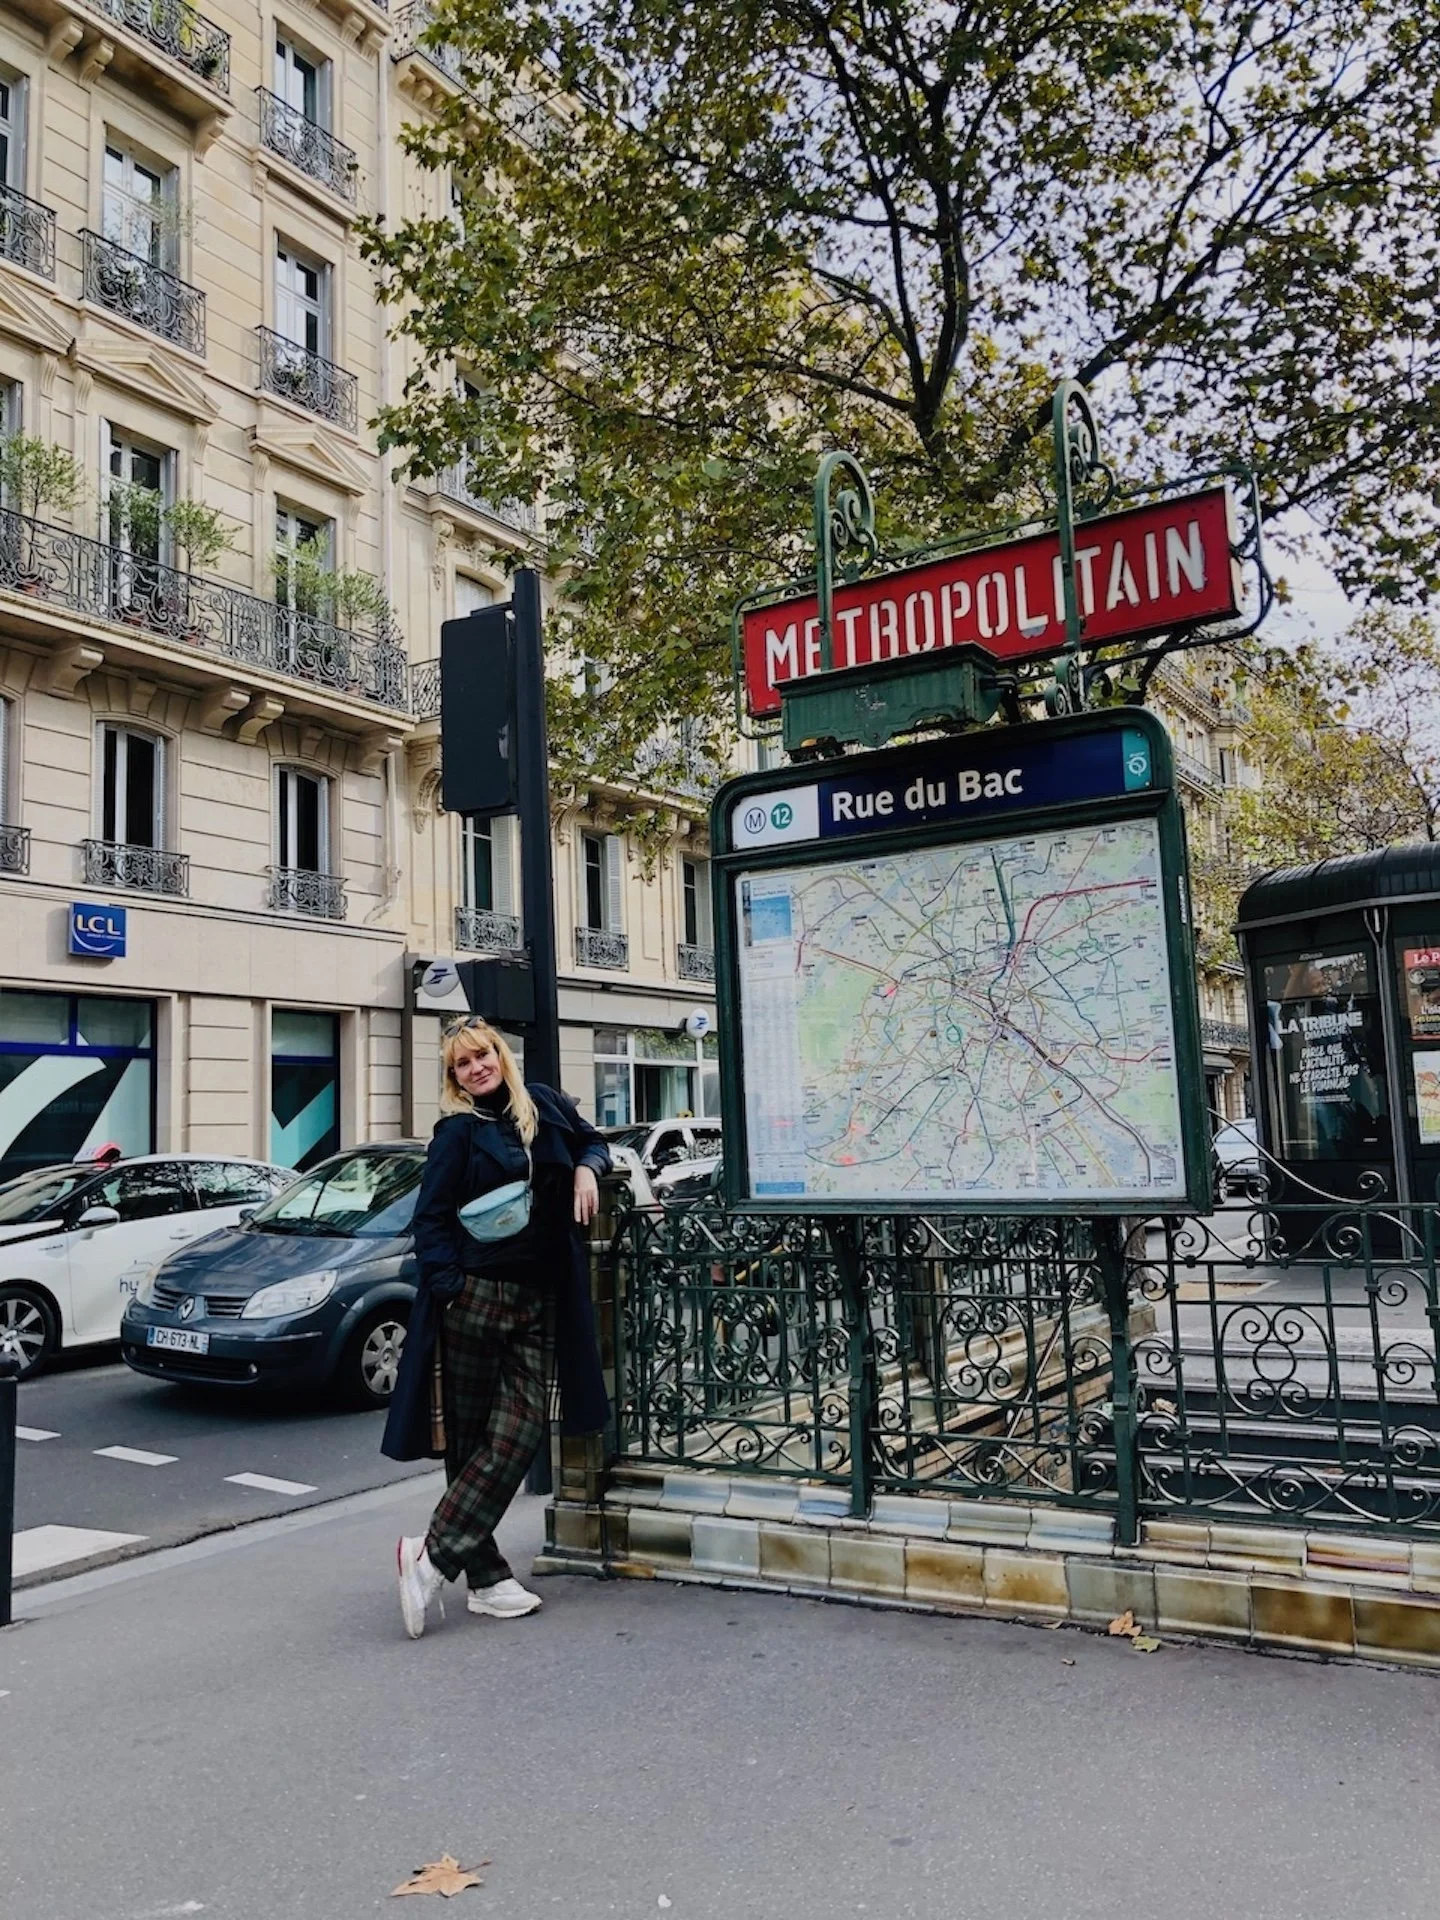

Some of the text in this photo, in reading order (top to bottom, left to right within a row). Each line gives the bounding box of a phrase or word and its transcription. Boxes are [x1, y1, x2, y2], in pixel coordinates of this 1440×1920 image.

[765, 519, 1206, 690] METROPOLITAIN
[771, 806, 791, 826] 12
[832, 790, 894, 821] Rue
[904, 777, 947, 811] du
[958, 768, 1024, 802] Bac
[77, 914, 121, 935] LCL
[1276, 1011, 1363, 1034] LA TRIBUNE
[1304, 1025, 1348, 1040] DIMANCHE
